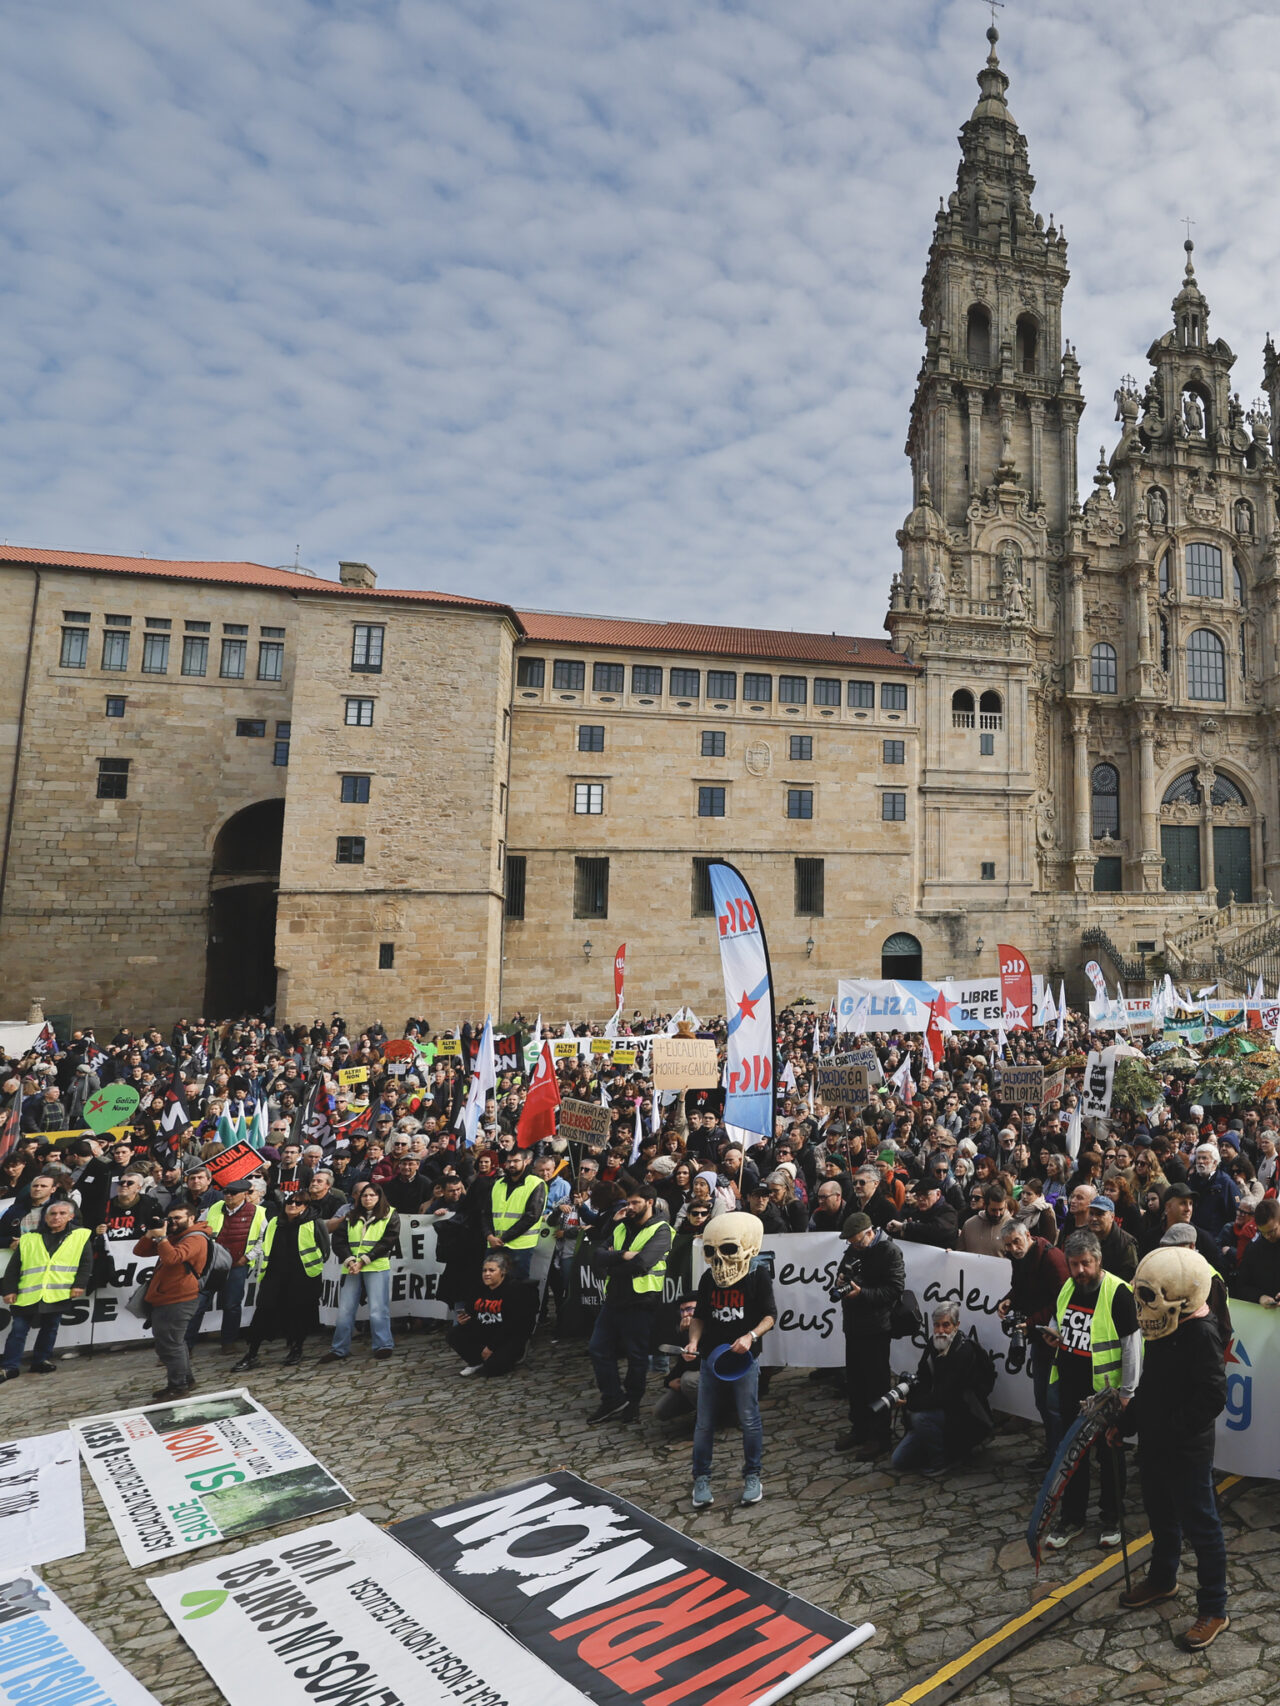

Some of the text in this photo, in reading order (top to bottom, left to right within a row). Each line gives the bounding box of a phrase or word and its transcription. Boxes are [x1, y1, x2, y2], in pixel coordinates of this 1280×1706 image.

[961, 989, 999, 1004] LIBRE
[961, 1008, 978, 1021] DE
[344, 1068, 362, 1076] ALTRI
[655, 1061, 681, 1076] MORTE
[688, 1063, 718, 1077] GALICIA
[115, 1096, 139, 1105] Galiza
[1016, 1086, 1043, 1100] LOITA!
[111, 1104, 130, 1112] Nova
[204, 1144, 250, 1172] ALQUILA
[922, 1269, 1003, 1315] adeu
[79, 1420, 122, 1448] SEXO
[158, 1425, 246, 1492] SI NON
[167, 1497, 219, 1543] SAUDE
[431, 1482, 688, 1620] NON
[266, 1620, 344, 1666] UN
[425, 1652, 478, 1690] NOSA
